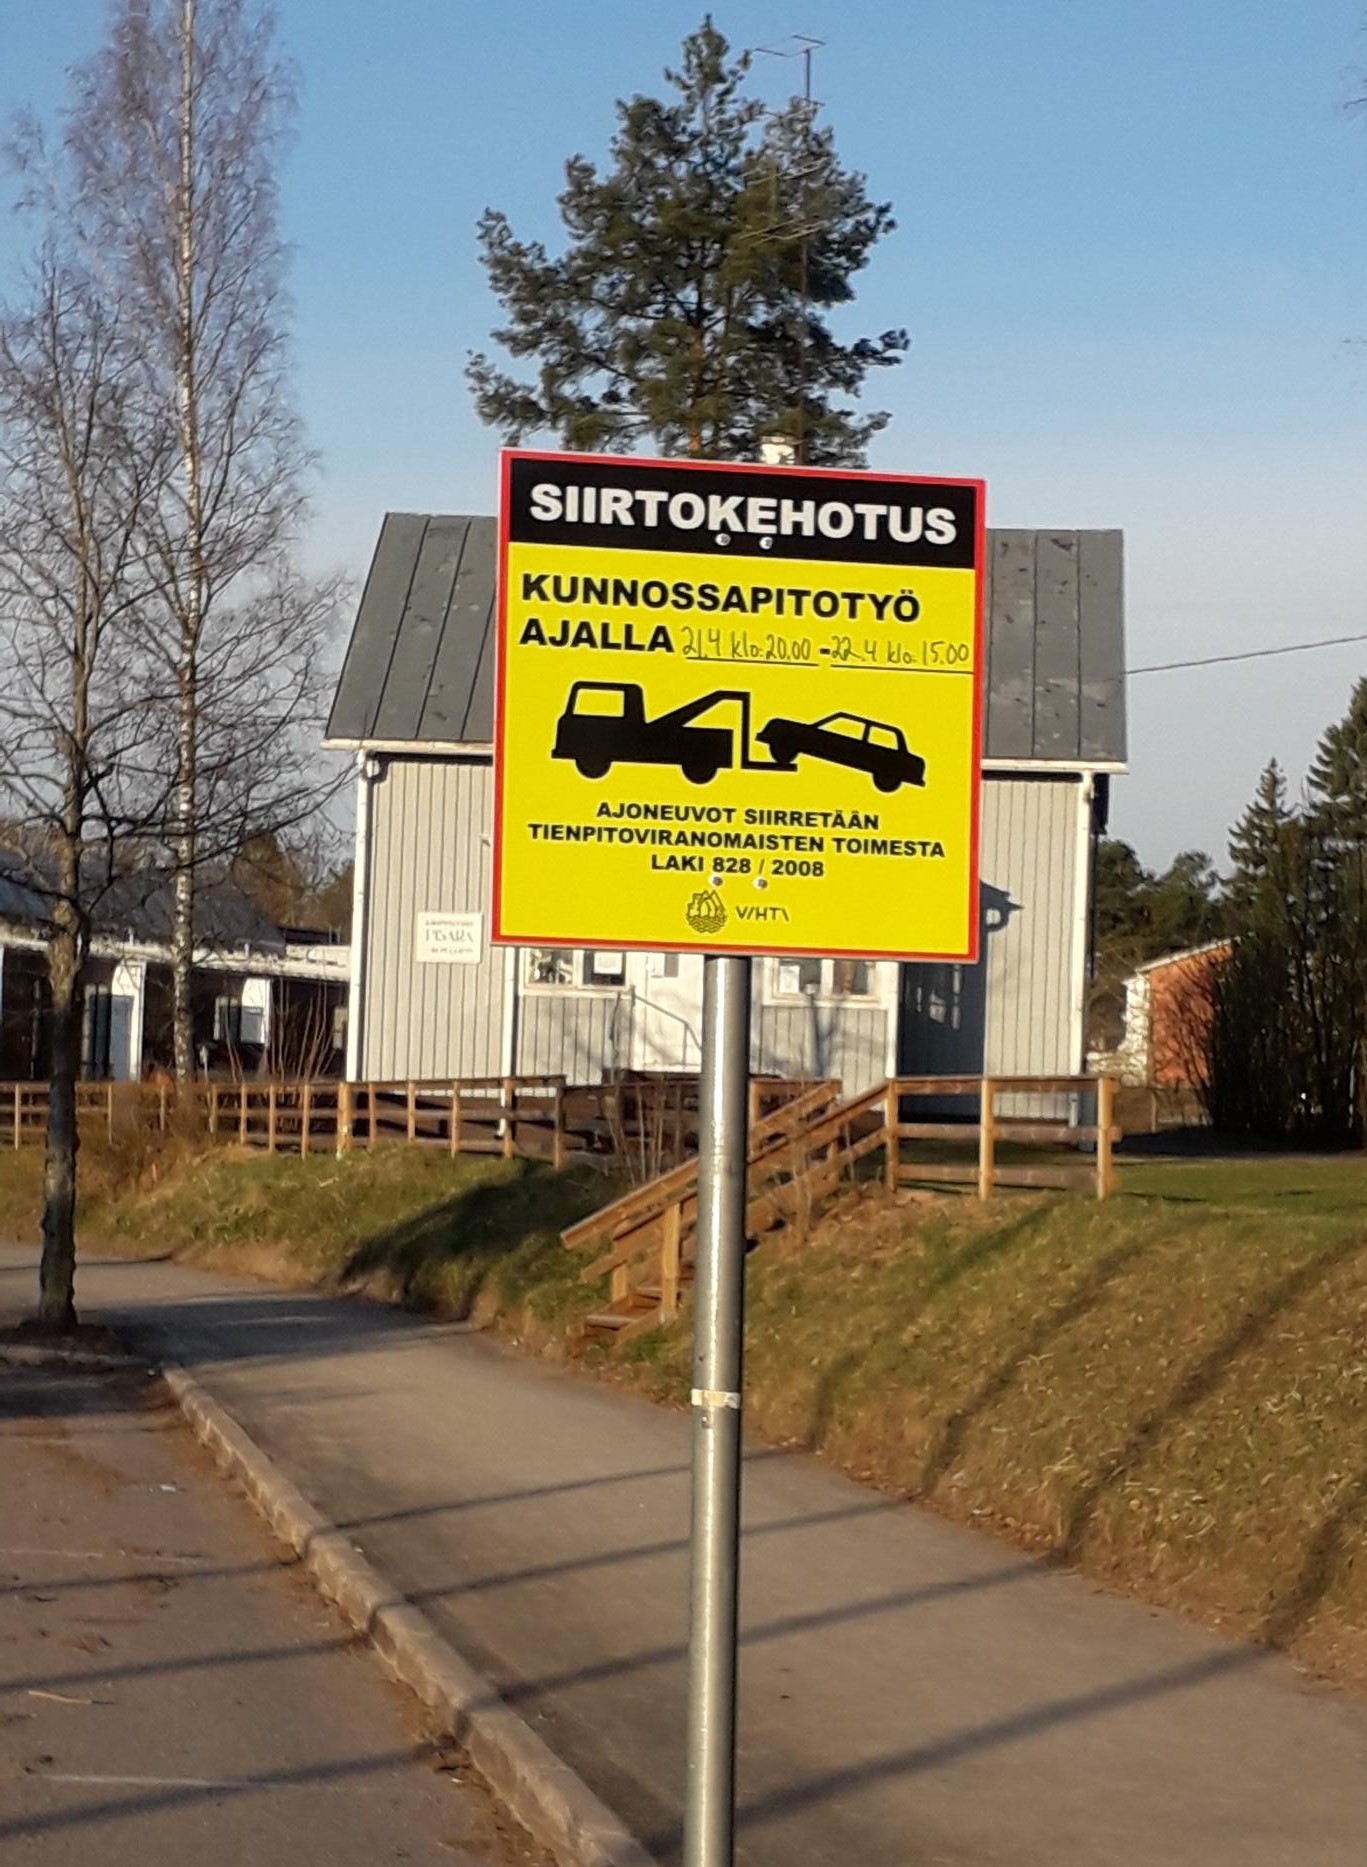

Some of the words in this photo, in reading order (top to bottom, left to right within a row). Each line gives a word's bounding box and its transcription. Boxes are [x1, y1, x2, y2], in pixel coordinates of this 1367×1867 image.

[530, 483, 957, 545] SIIRTOKEHOTUS
[522, 573, 920, 623] KUNNOSSAPITOTYÖ
[519, 618, 675, 653] AJALLA
[766, 634, 811, 660] 20.00
[596, 802, 736, 823] AJONEUVOT
[744, 807, 879, 830] SIIRRETÄÄN
[528, 823, 824, 853] TIENPITOVIRANOMAISTEN
[832, 837, 945, 857] TOIMESTA
[651, 854, 704, 872] LAKI
[712, 856, 751, 874] 828
[771, 859, 824, 877] 2008
